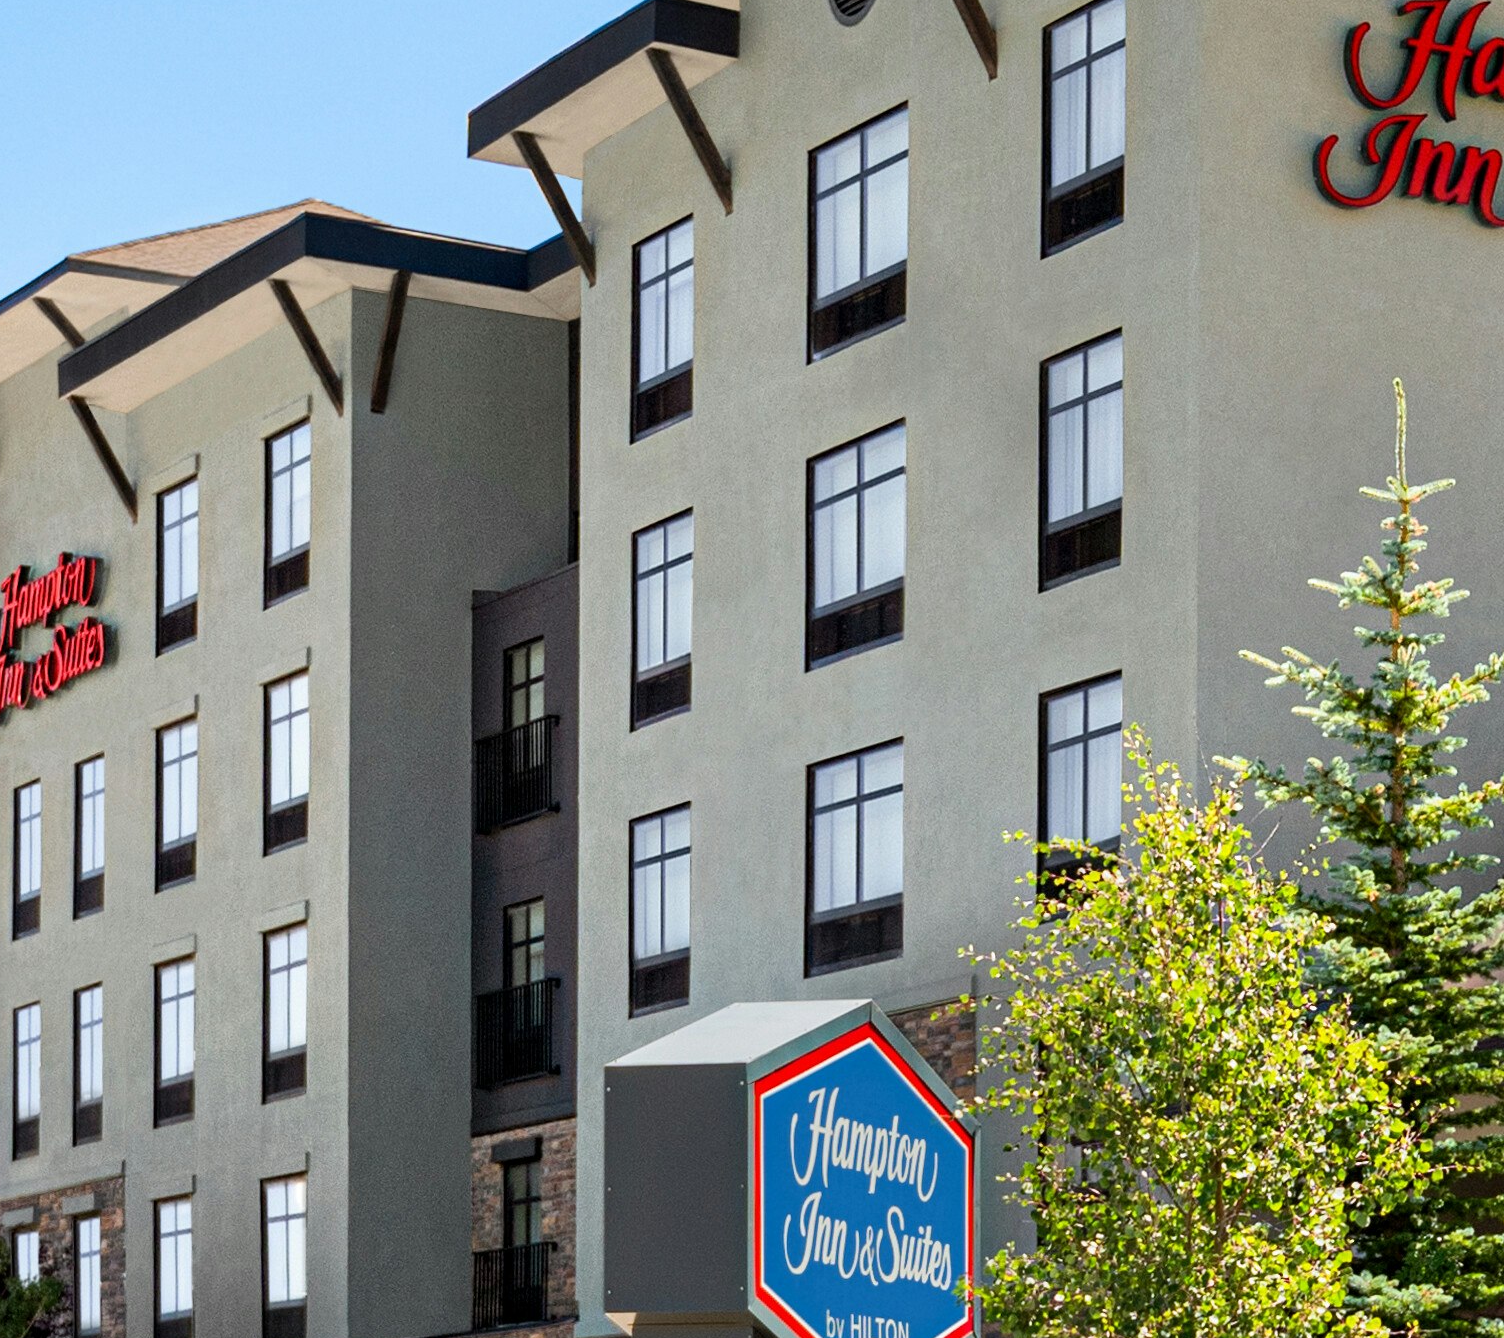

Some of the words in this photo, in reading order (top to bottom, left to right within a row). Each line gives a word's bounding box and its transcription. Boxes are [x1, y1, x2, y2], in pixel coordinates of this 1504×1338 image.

[45, 617, 109, 692] Suites
[789, 1086, 939, 1203] Hampton
[783, 1191, 860, 1281] Inn
[859, 1225, 879, 1287] &
[876, 1206, 952, 1292] Suites
